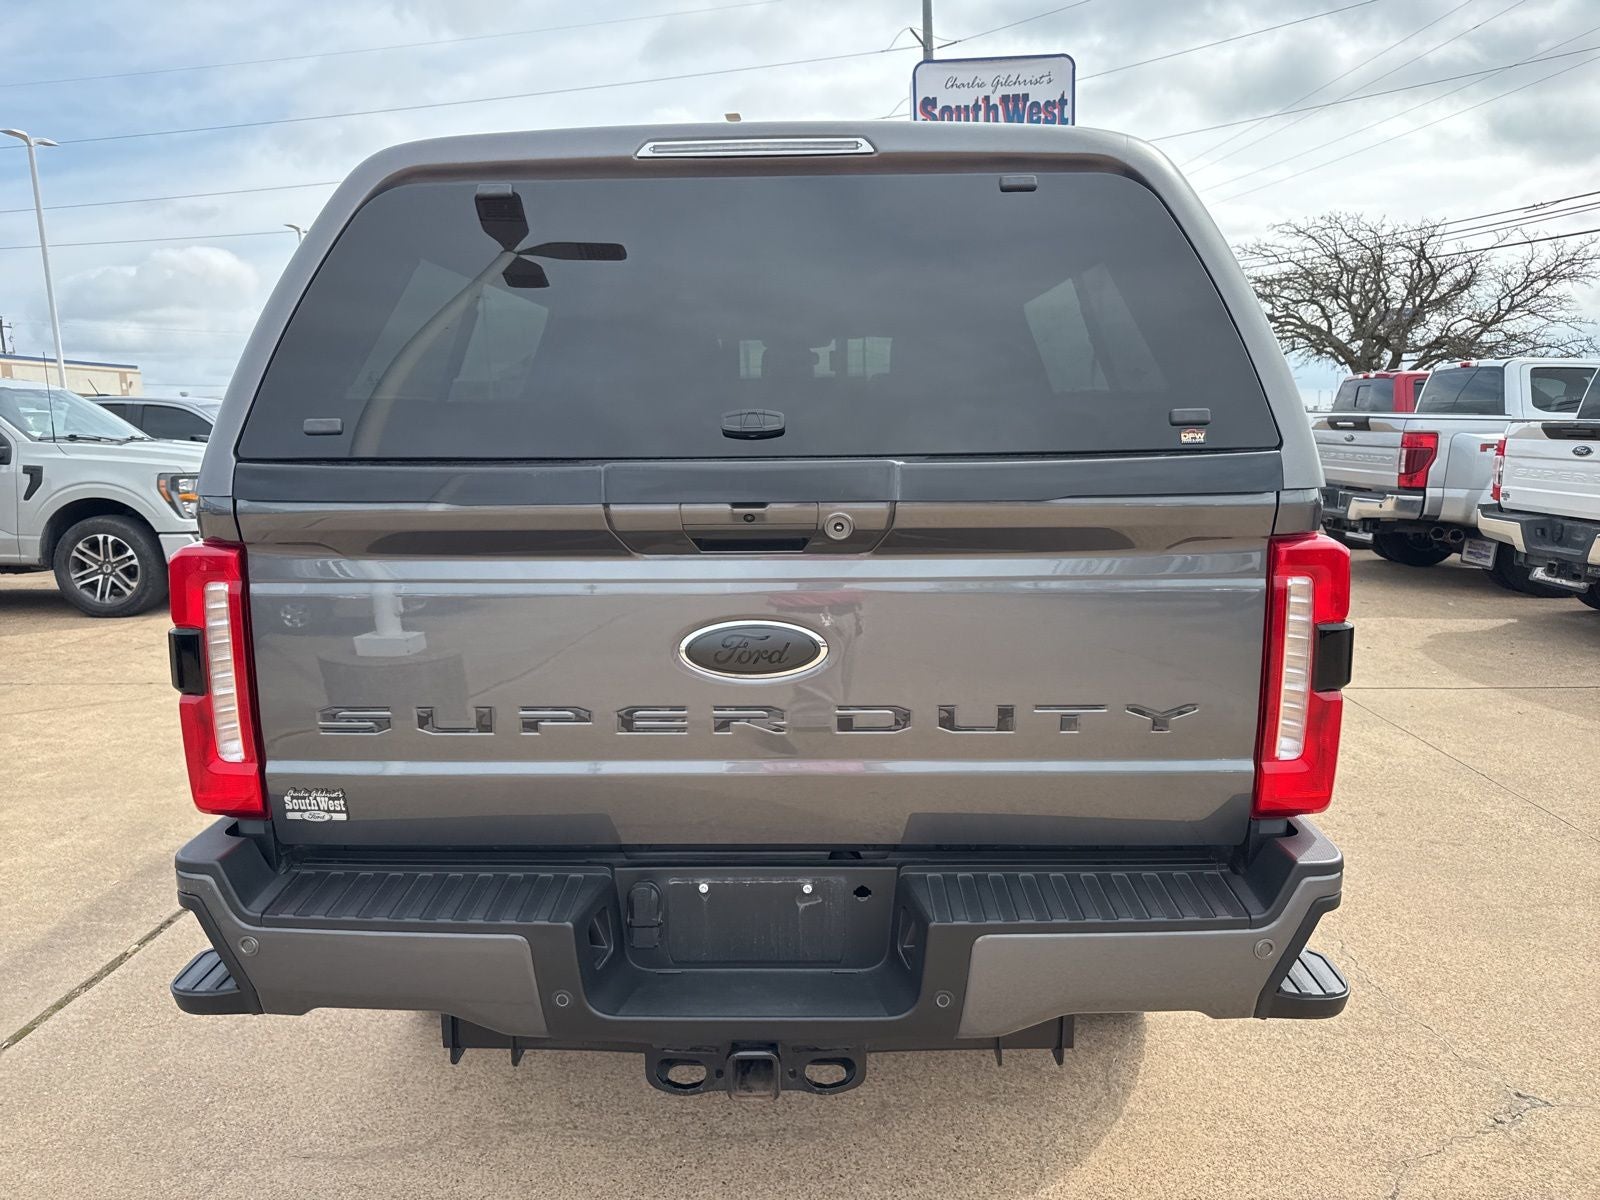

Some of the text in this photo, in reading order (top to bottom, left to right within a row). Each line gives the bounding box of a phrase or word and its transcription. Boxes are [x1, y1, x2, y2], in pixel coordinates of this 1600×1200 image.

[944, 70, 1054, 94] Charlie Gilchrist's
[919, 91, 1069, 125] SouthWest
[713, 633, 792, 665] Ford
[317, 704, 1200, 736] SUPER DUTY
[284, 795, 346, 811] SouthWest
